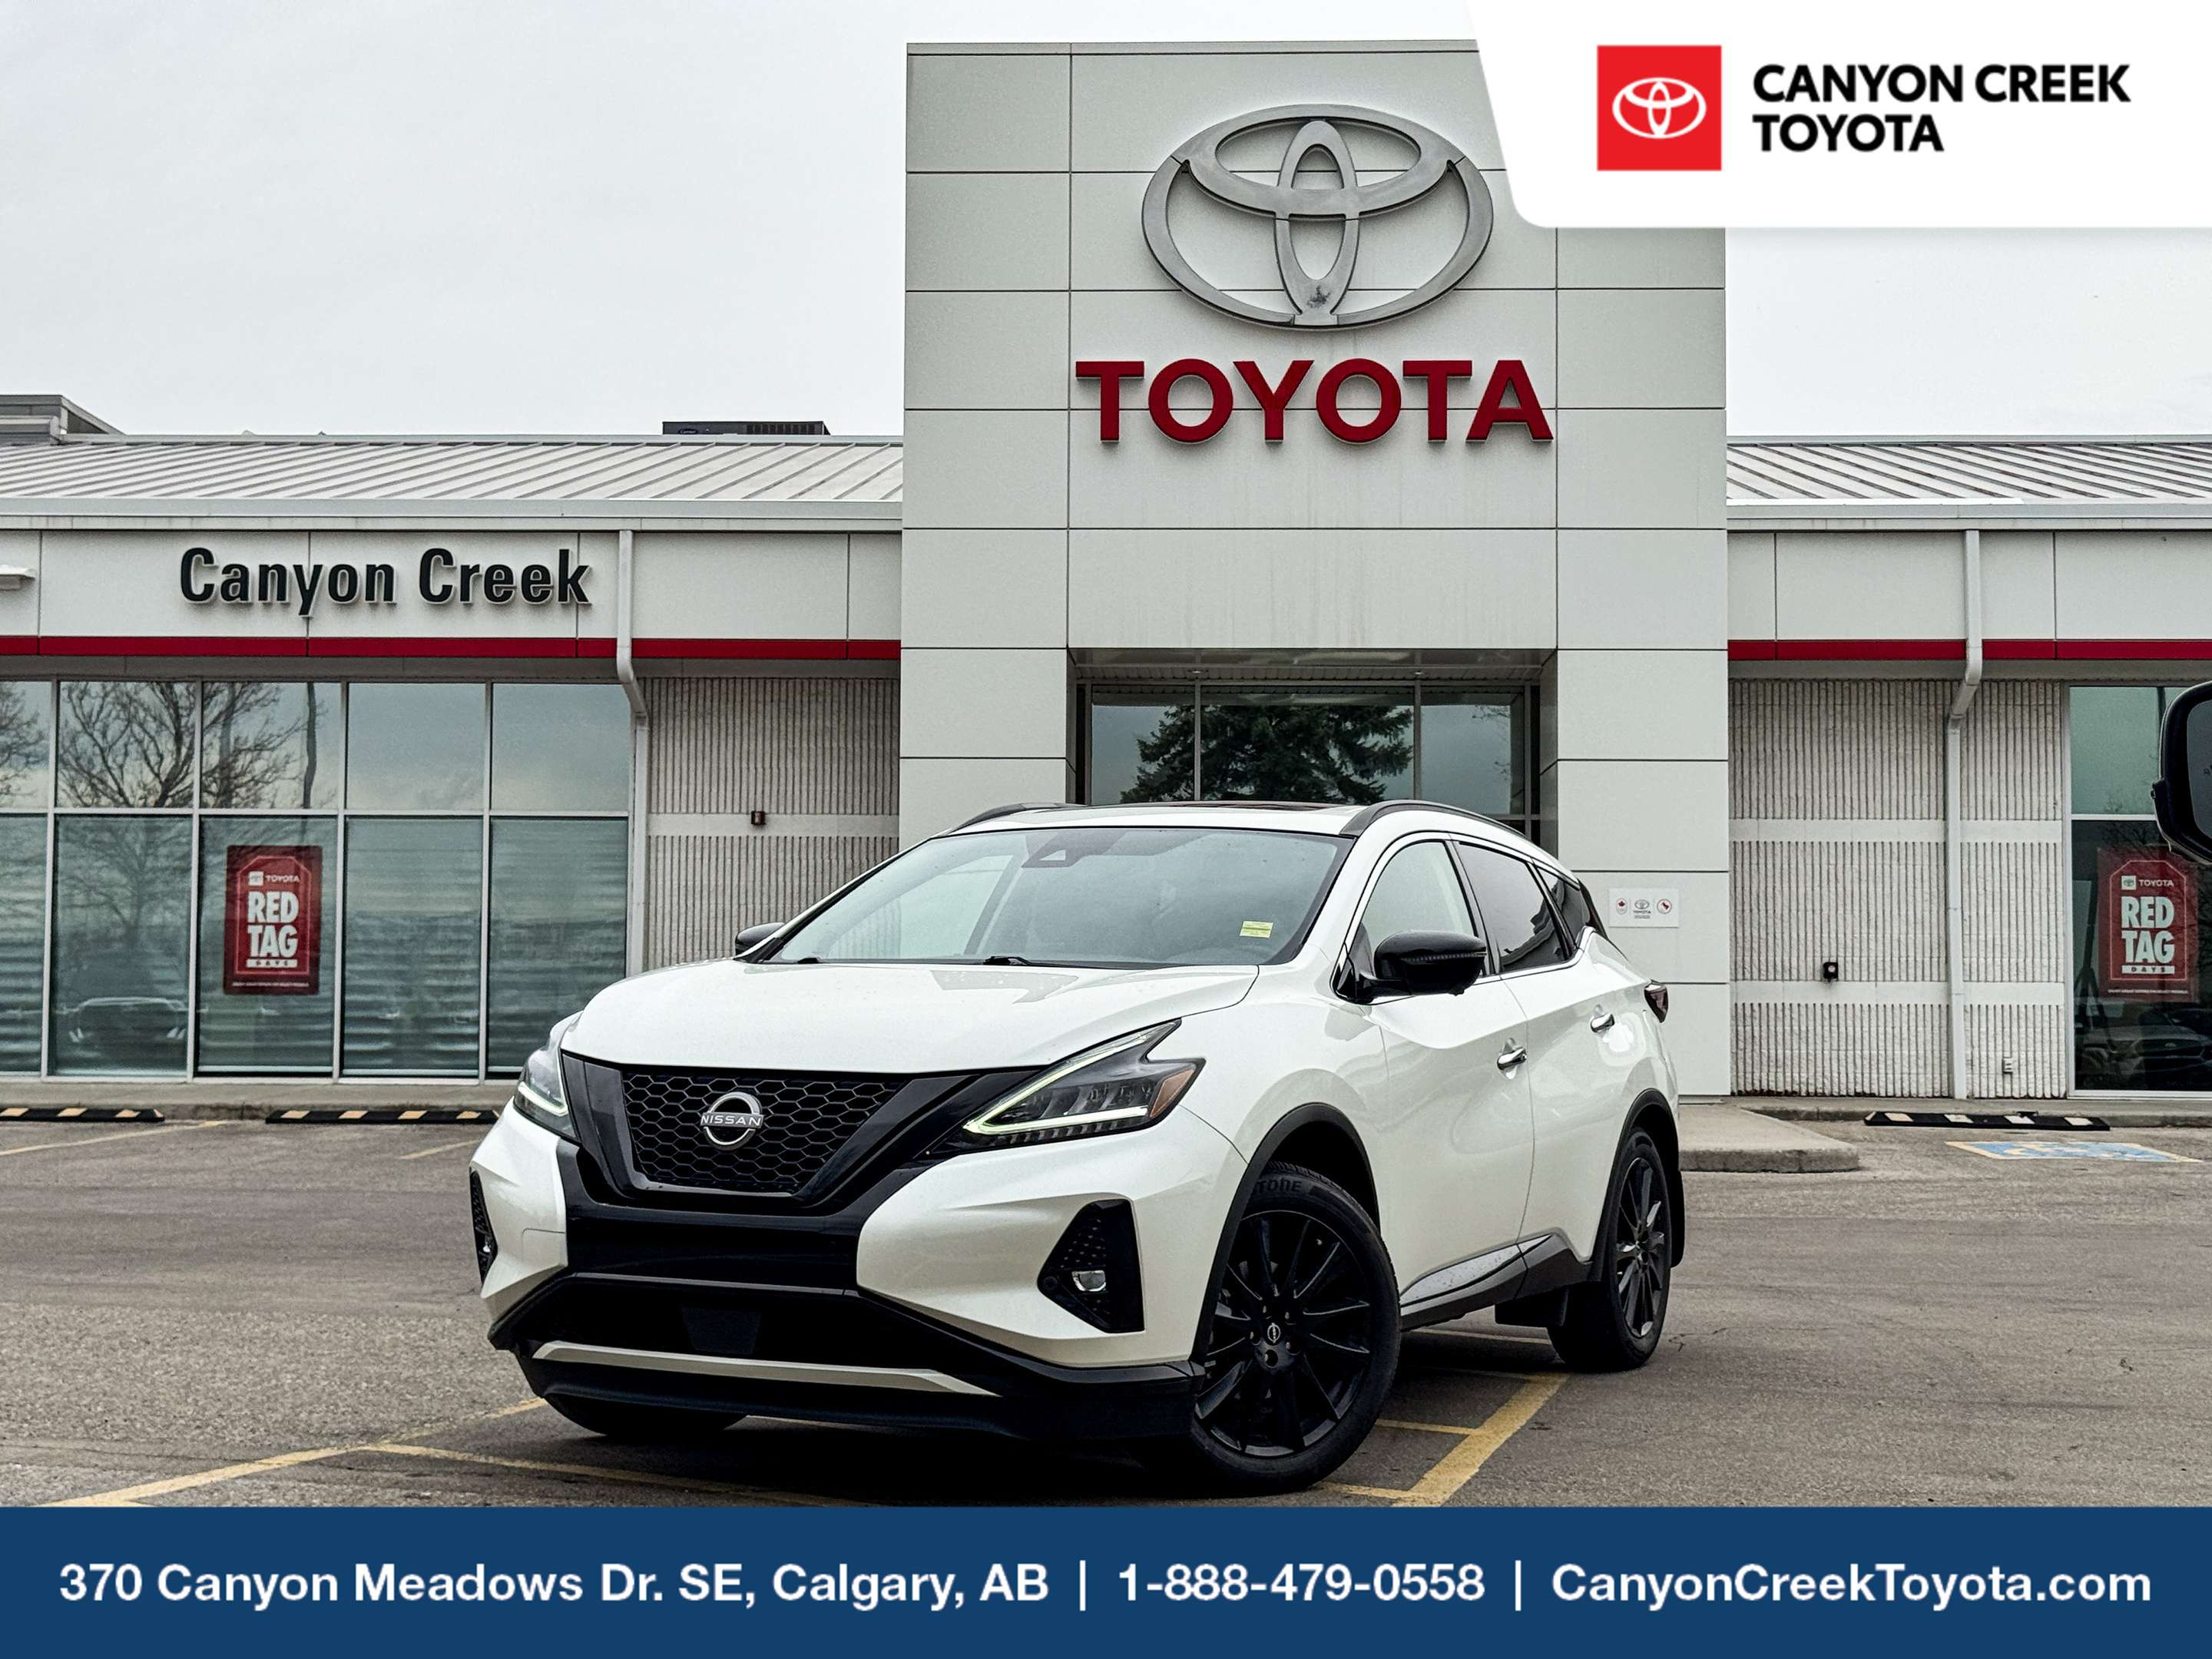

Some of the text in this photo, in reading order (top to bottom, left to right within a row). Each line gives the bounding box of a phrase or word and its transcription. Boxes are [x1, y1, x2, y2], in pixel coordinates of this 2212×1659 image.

[1076, 358, 1553, 443] TOYOTA
[180, 547, 591, 616] Canyon Creek
[265, 875, 300, 883] TOYOTA
[2138, 879, 2174, 887] TOYOTA
[247, 890, 300, 923] RED
[2121, 896, 2175, 929] RED
[247, 924, 299, 958] TAG
[2121, 930, 2175, 964] TAG
[700, 1114, 761, 1126] NISSAN
